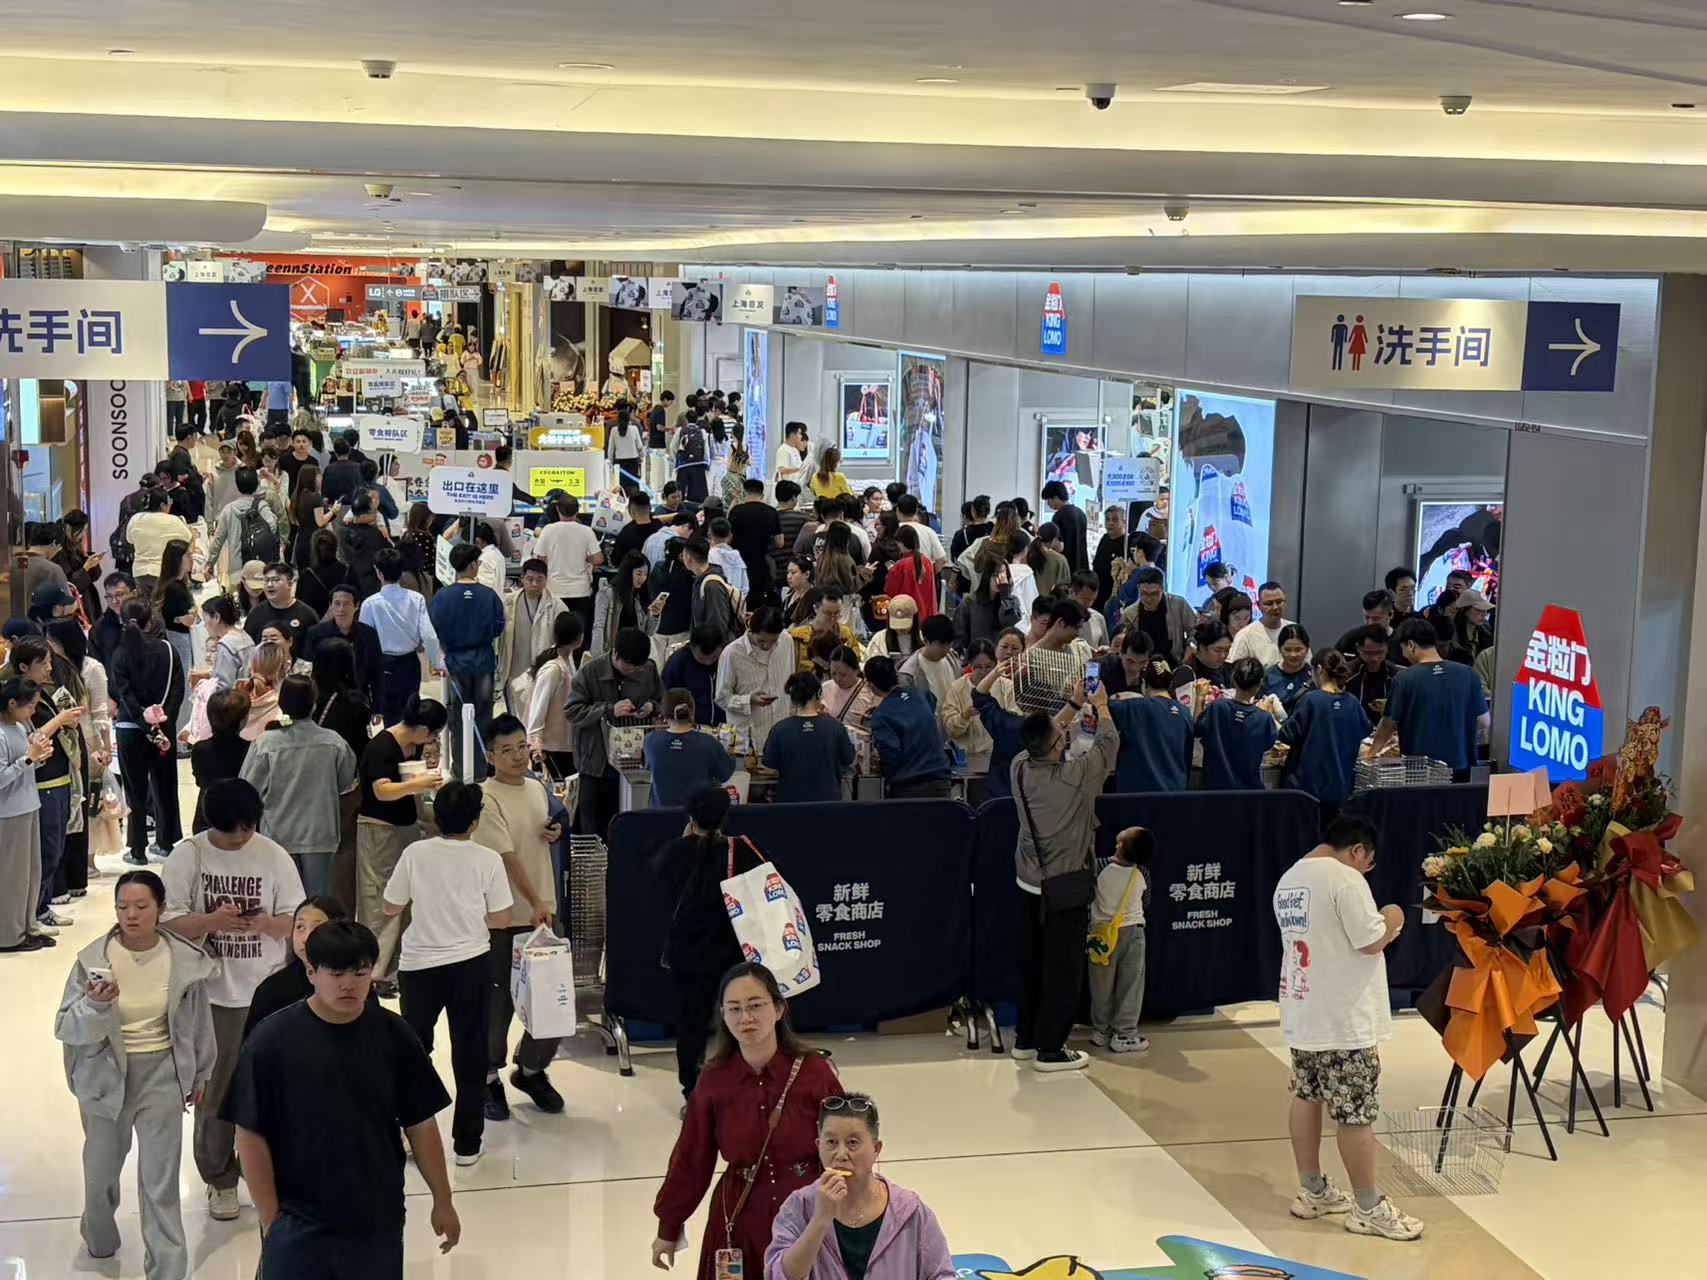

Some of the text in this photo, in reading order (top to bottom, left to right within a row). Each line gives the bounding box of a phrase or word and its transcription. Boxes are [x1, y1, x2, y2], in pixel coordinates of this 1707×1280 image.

[265, 263, 352, 275] eennStation
[1045, 312, 1061, 328] KING
[1043, 329, 1062, 346] LOMO
[1374, 323, 1492, 367] 洗手间
[368, 428, 408, 438] 零食排队区
[443, 480, 499, 494] 出口在这里
[1524, 630, 1592, 686] 金粒门
[1528, 676, 1585, 727] KING
[1520, 715, 1589, 771] LOMO
[1186, 862, 1222, 882] 新鲜
[202, 872, 262, 897] CHALLENGE
[833, 882, 870, 902] 新鲜
[1169, 880, 1236, 902] 零食商店
[815, 900, 885, 923] 零食商店
[1187, 909, 1218, 920] FRESH
[1172, 918, 1233, 930] SNACK SHOP
[833, 930, 866, 941] FRESH
[817, 939, 881, 952] SNACK SHOP
